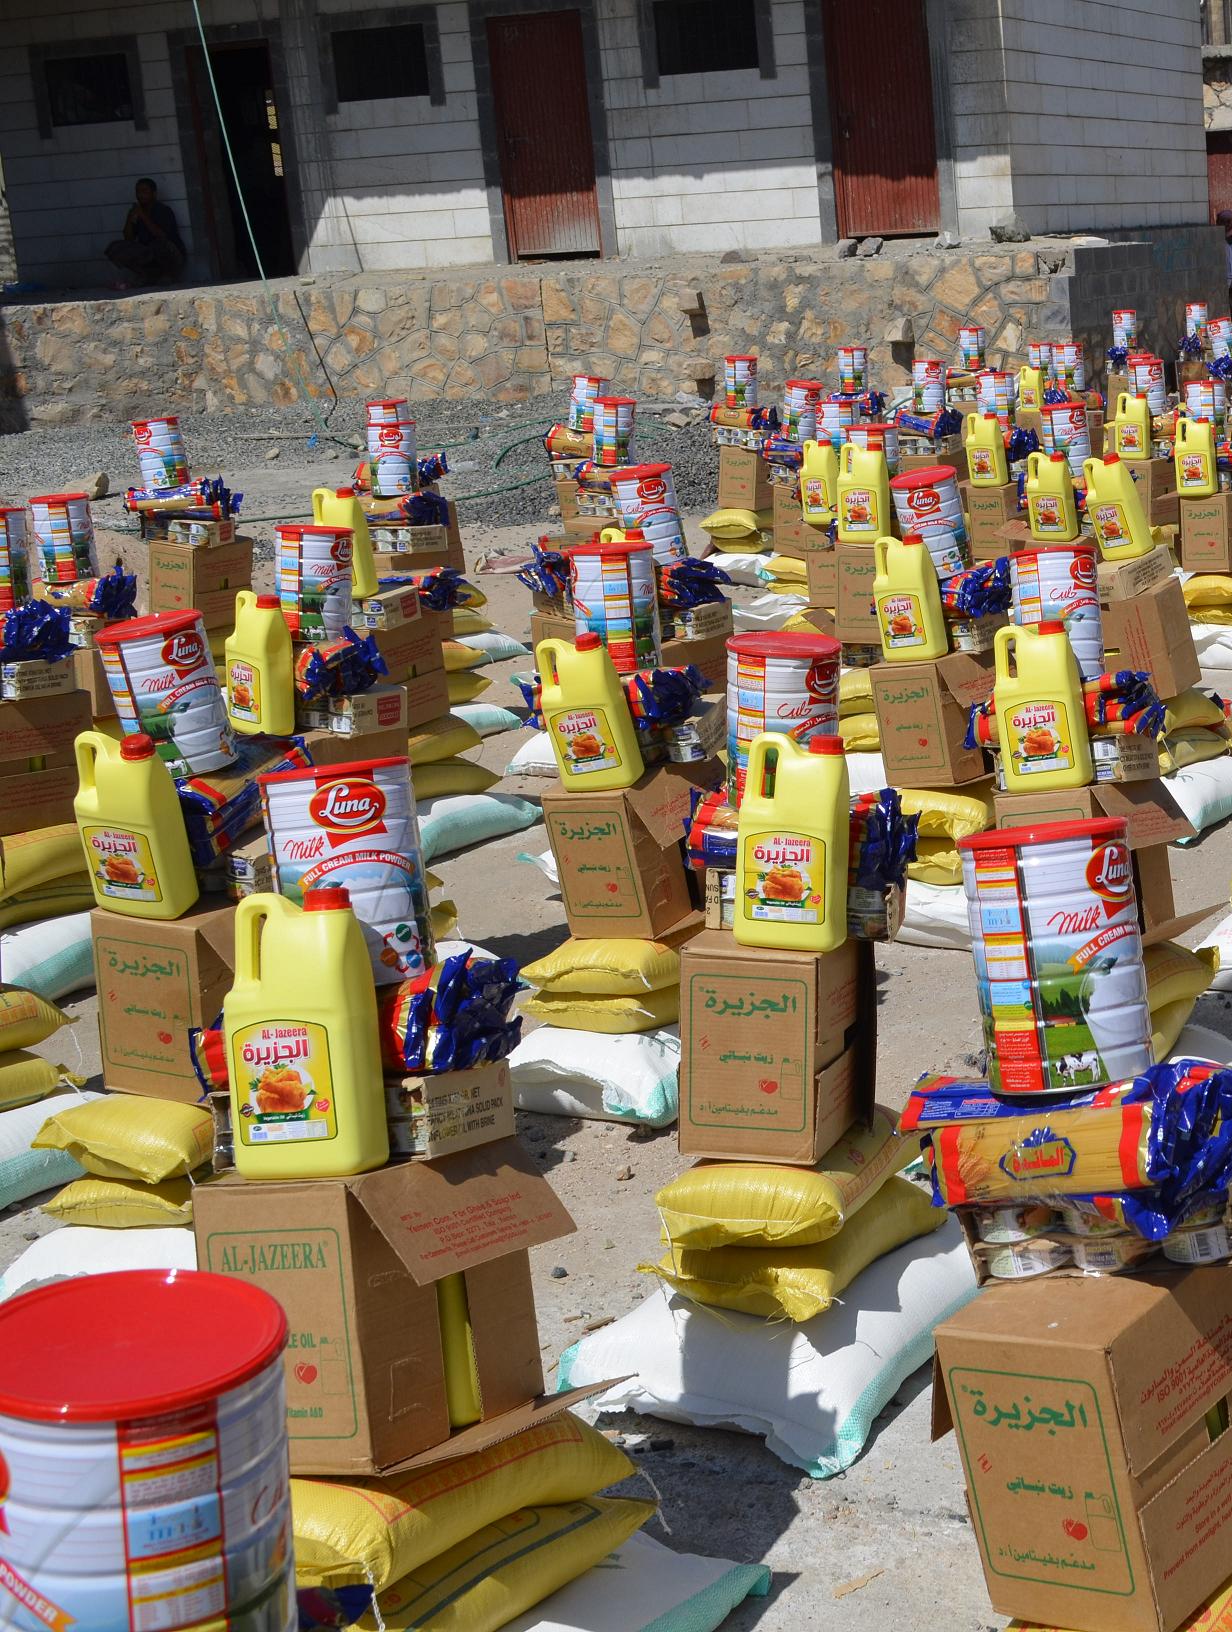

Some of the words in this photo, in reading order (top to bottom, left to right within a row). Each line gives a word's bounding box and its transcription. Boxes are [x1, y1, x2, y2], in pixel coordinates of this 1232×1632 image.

[910, 492, 936, 510] Luna
[1050, 587, 1078, 601] حليب
[168, 635, 199, 662] Luna
[141, 673, 176, 693] Milk
[162, 693, 176, 708] FULL
[776, 701, 813, 719] حليب
[558, 717, 597, 734] الجزيرة
[1012, 711, 1056, 728] الجزيرة
[319, 784, 377, 824] Luna
[560, 821, 617, 841] الجزيرة
[91, 835, 138, 854] الجزيرة
[283, 835, 325, 860] Milk
[753, 845, 811, 866] الجزيرة
[303, 869, 323, 886] FULL
[321, 855, 354, 873] CREAM
[355, 851, 378, 862] MILK
[379, 852, 412, 870] POWDER
[1047, 905, 1101, 935] Milk
[1076, 941, 1100, 964] FULL
[1098, 923, 1126, 947] CREAM
[108, 950, 182, 982] الجزيرة
[703, 986, 798, 1017] الجزيرة
[275, 1027, 308, 1038] Jazeera
[242, 1039, 309, 1066] الجزيرة
[221, 1242, 328, 1274] AL-JAZEERA
[300, 1332, 317, 1349] OIL
[969, 1389, 1089, 1437] الجزيرة
[1006, 1475, 1047, 1496] نباتي
[1047, 1481, 1075, 1500] زيت
